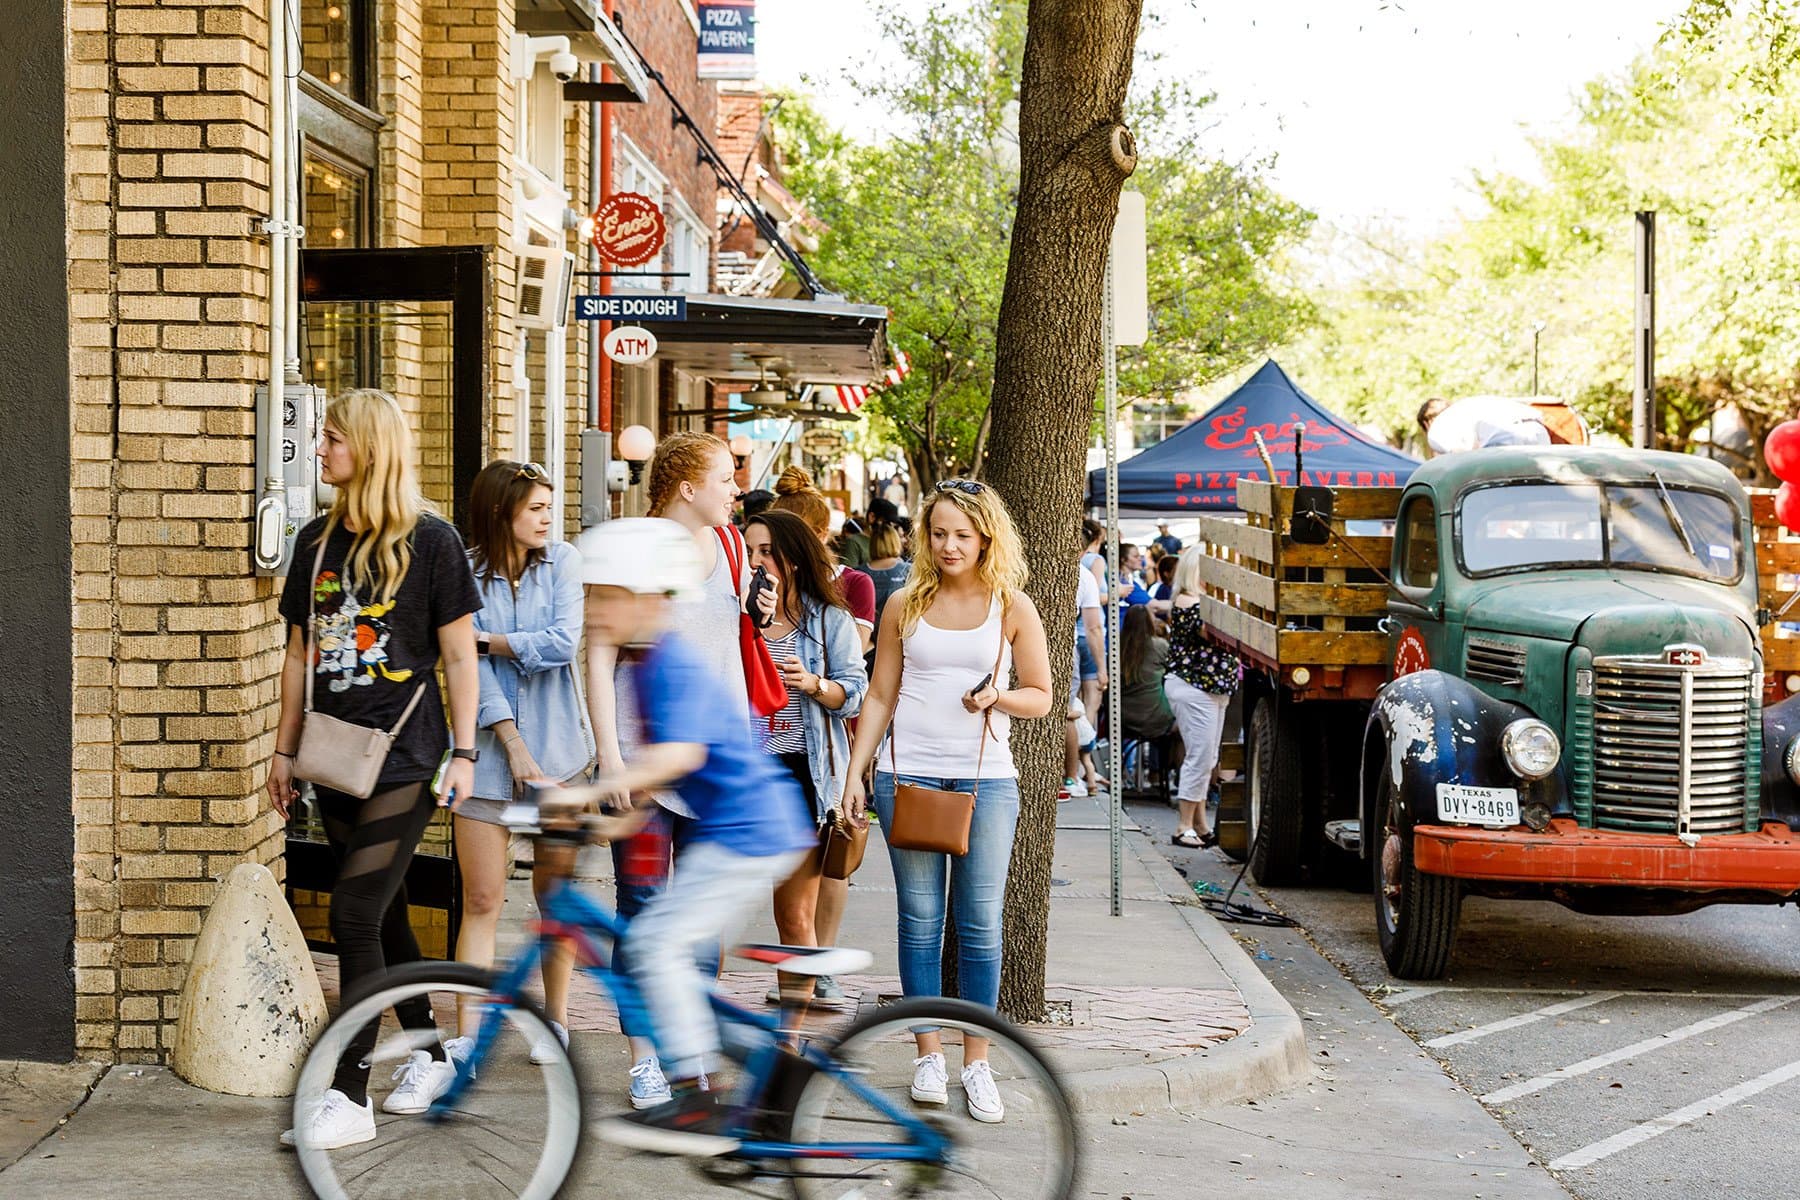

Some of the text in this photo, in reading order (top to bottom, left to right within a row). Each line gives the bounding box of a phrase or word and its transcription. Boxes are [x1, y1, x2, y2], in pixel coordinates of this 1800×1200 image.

[706, 9, 742, 26] PIZZA
[702, 30, 747, 47] TAVERN
[618, 197, 650, 211] TAVERN
[602, 209, 659, 243] Eno's
[584, 299, 677, 315] SIDE DOUGH
[614, 338, 648, 356] ATM
[1274, 470, 1396, 487] TAVERN
[1462, 789, 1491, 797] TEXAS
